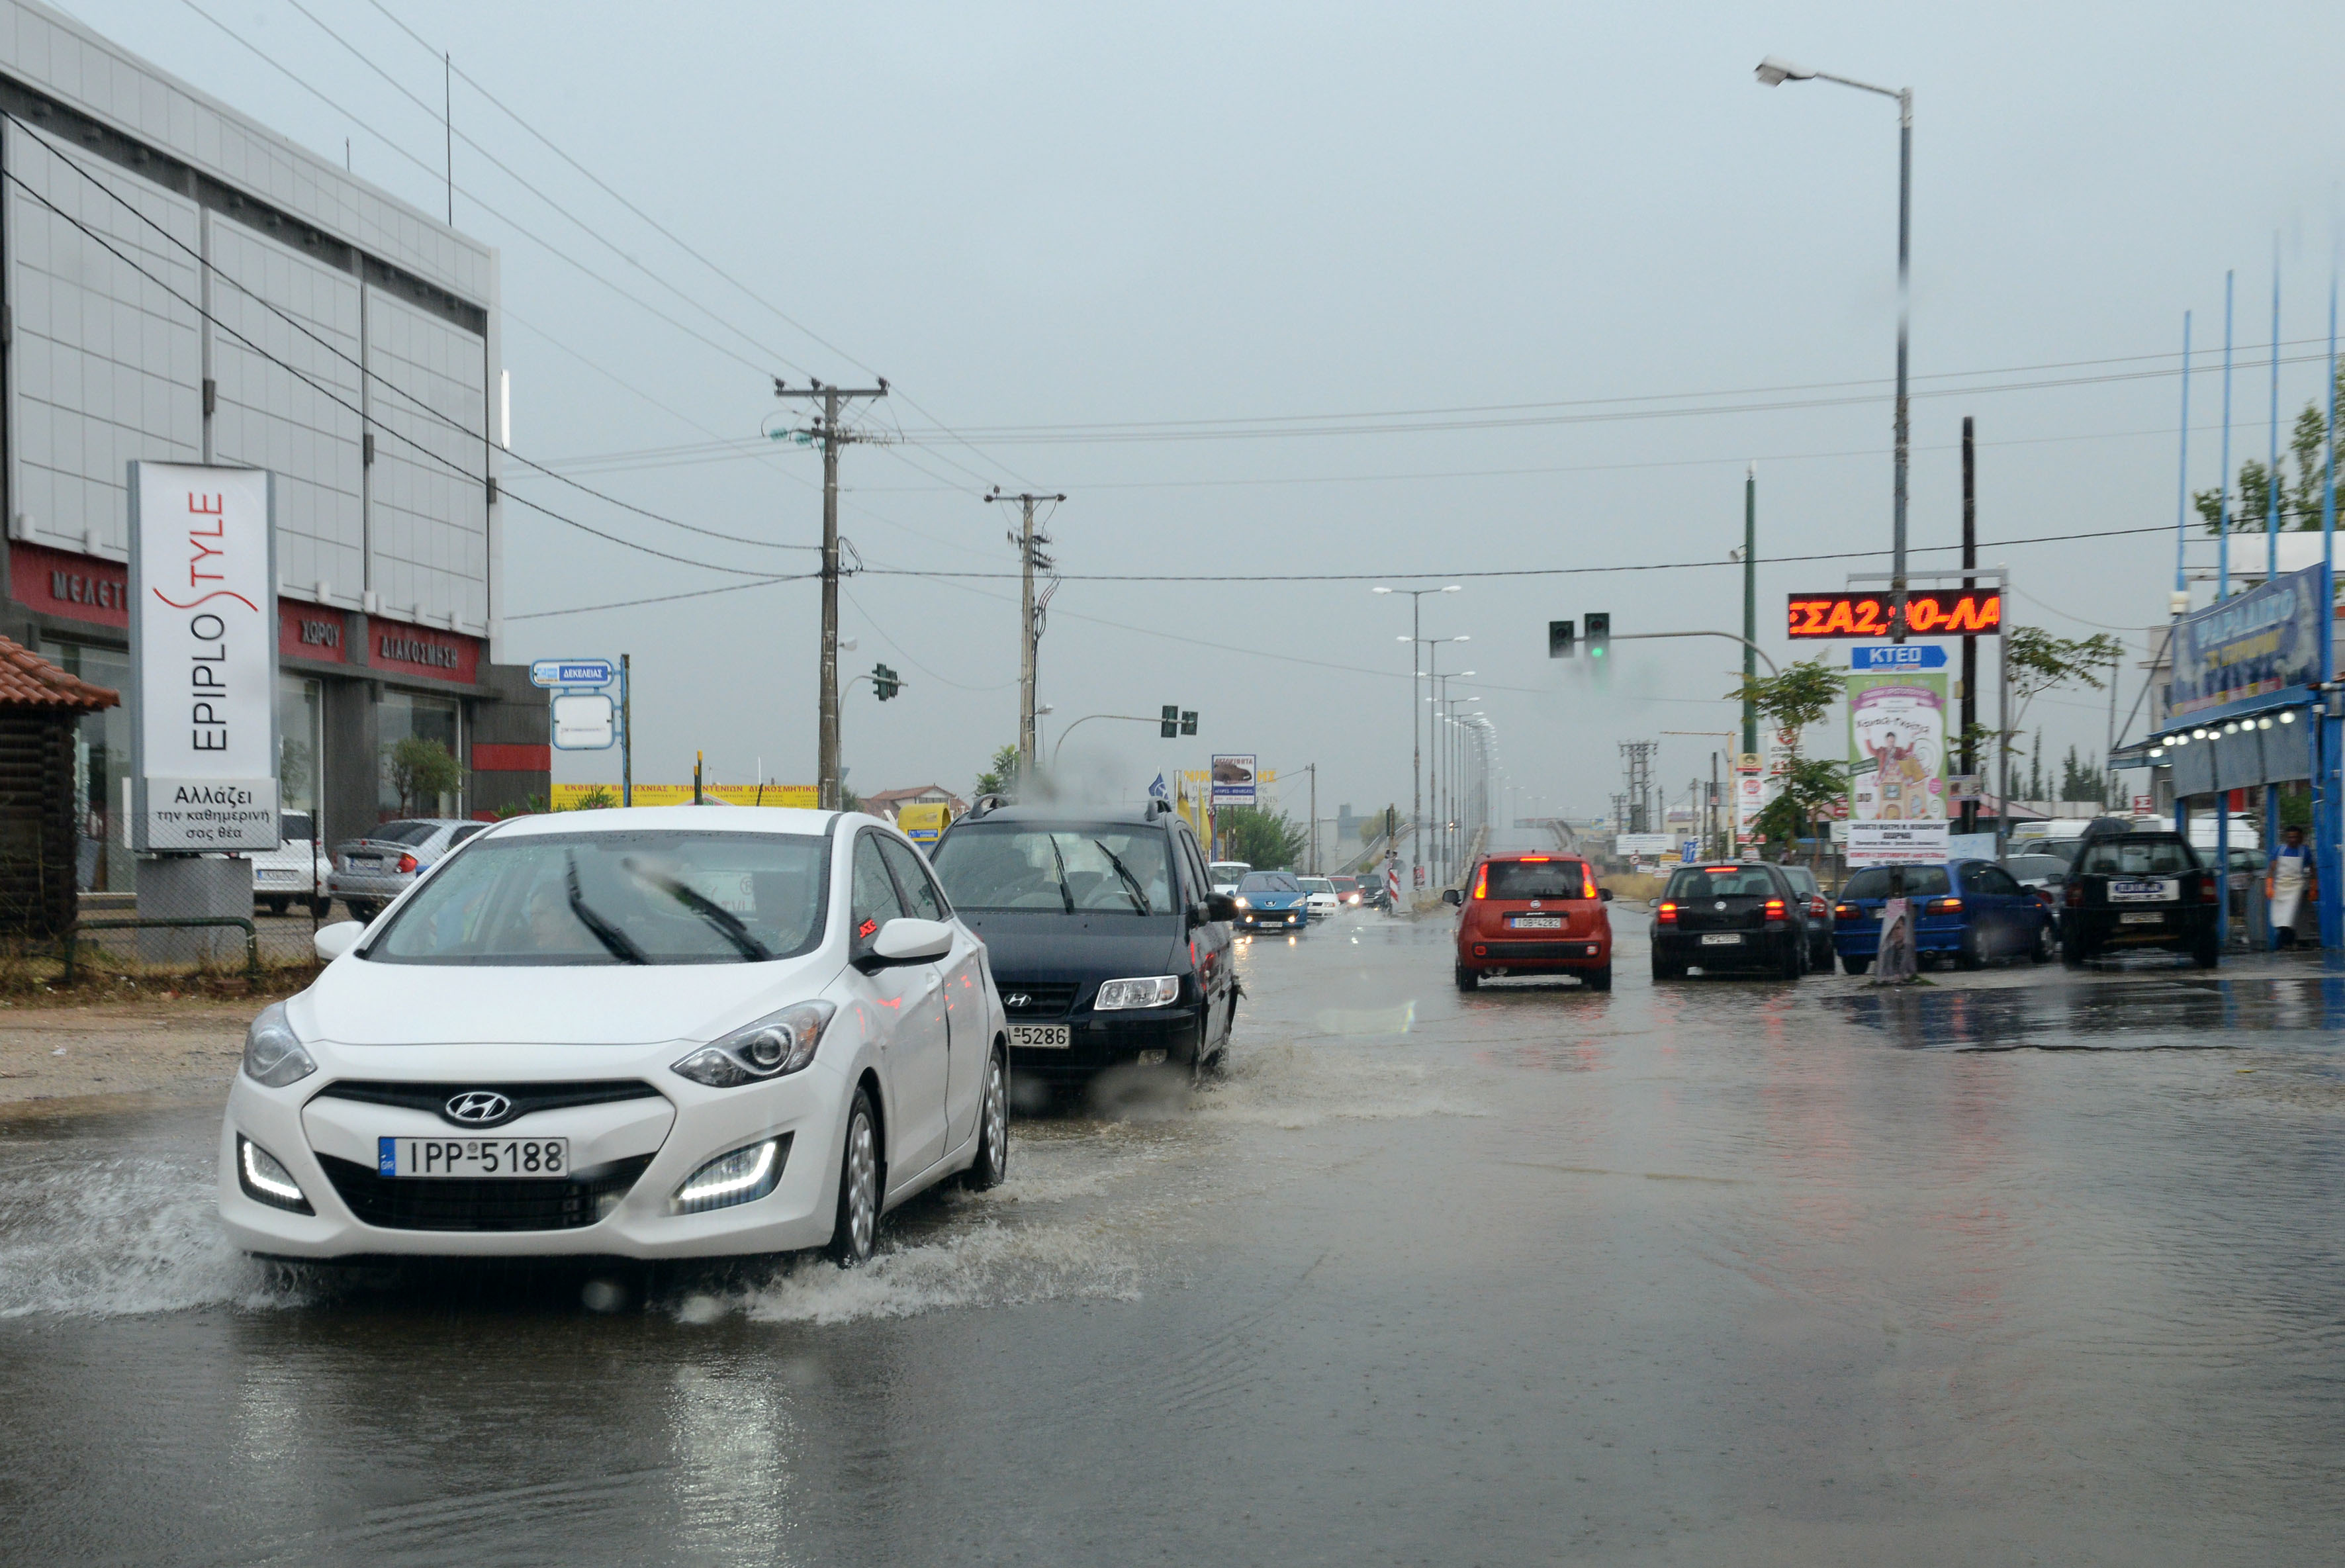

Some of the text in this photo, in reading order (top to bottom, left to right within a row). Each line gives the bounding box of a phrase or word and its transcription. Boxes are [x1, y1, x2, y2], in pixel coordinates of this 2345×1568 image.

[51, 569, 129, 609] ΜΕΛΕΤ
[300, 620, 339, 648] ΧΩΡΟΥ
[381, 634, 458, 669] ΔΙΑΚΟΣΜΗΣΗ
[1869, 646, 1922, 663] ΚΤΕΟ
[191, 613, 228, 753] EPIPLO
[563, 668, 603, 678] ΔΕΚΕΛΕΙΑΣ
[174, 785, 253, 808] Αλλάζει
[158, 809, 270, 823] την καθημερινή
[186, 827, 242, 841] σας θέα
[411, 1142, 562, 1173] IPP-5188
